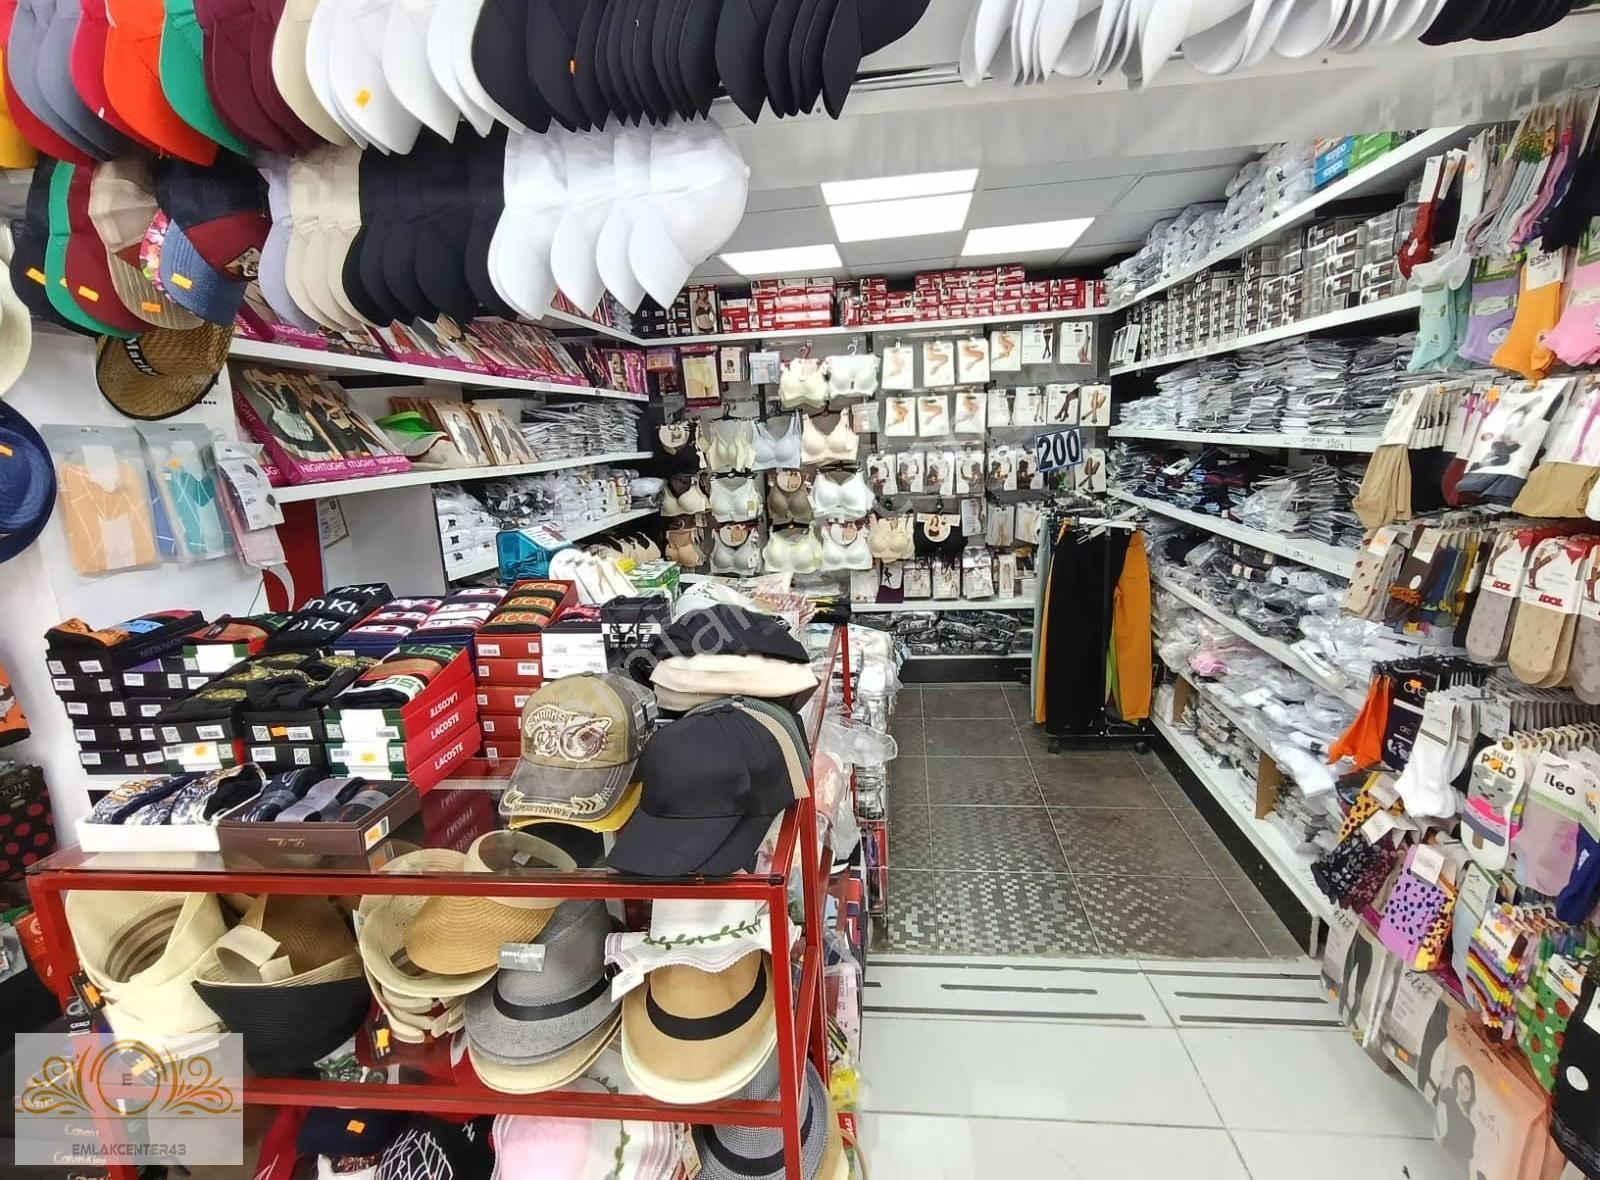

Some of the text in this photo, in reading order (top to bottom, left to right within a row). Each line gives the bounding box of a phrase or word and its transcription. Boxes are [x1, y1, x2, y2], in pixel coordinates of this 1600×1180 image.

[1038, 430, 1080, 468] 200
[429, 691, 459, 719] LACOSTE
[431, 712, 460, 740] LACOSTE
[433, 741, 464, 770] LACOSTE
